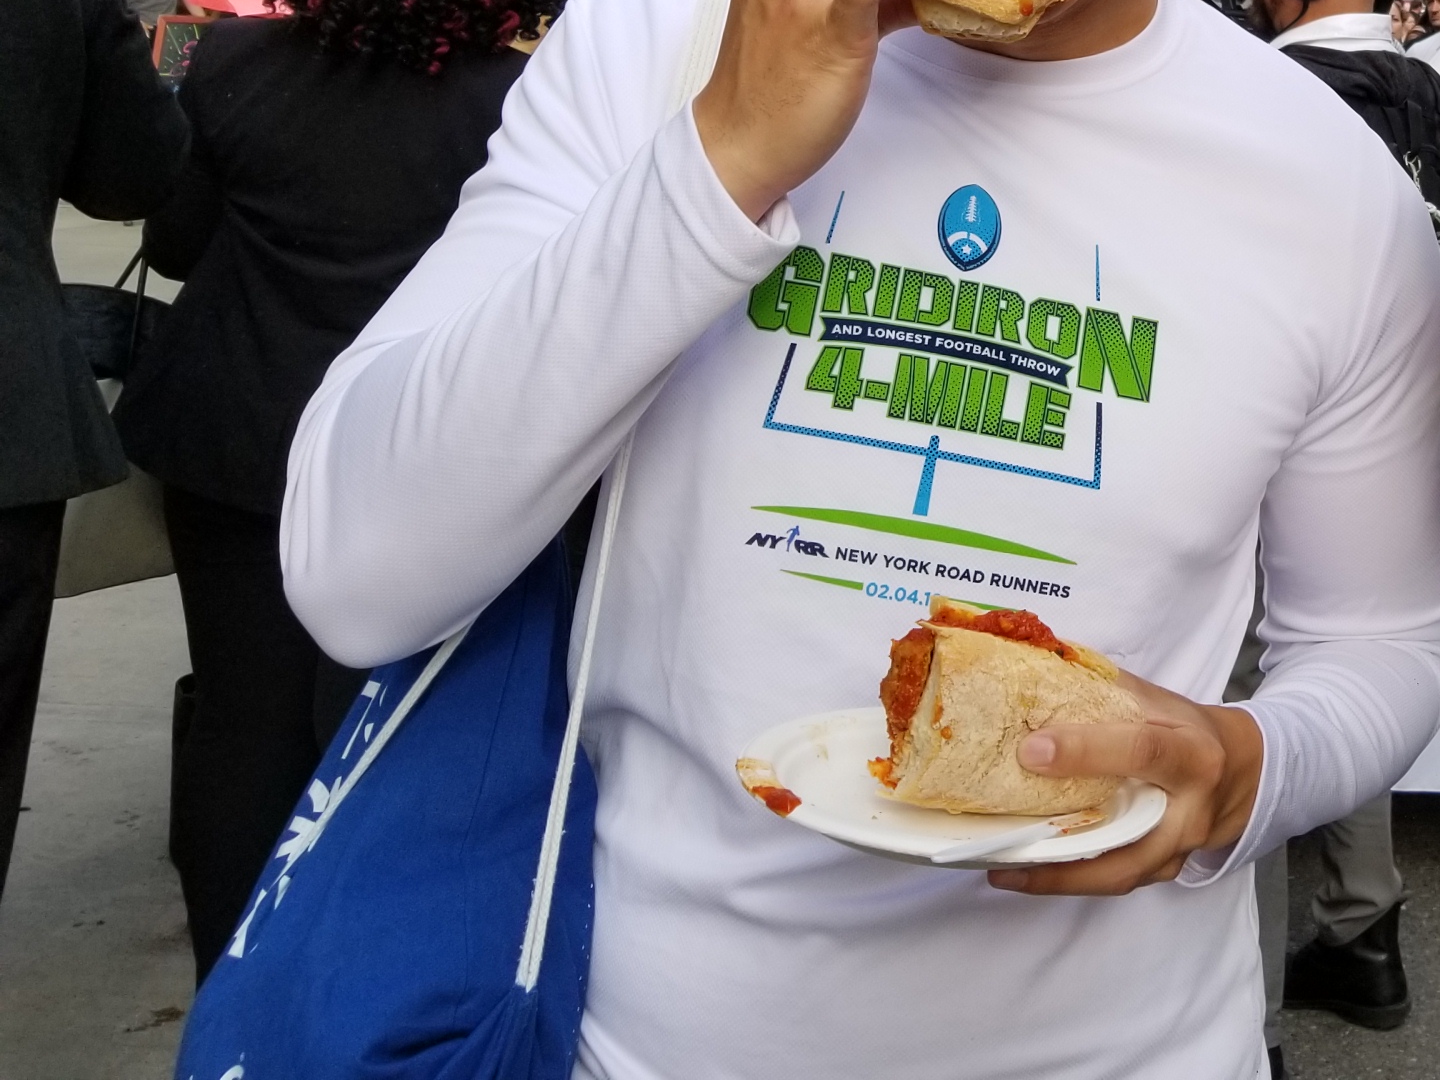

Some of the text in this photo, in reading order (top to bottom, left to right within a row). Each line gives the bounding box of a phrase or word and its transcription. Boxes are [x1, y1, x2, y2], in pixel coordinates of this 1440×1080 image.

[747, 245, 1159, 403] GRIDIRON
[831, 323, 1062, 377] AND LONGEST FOOTBALL THROW
[804, 345, 1072, 451] 4-MILE
[834, 546, 878, 565] NEW
[883, 554, 931, 575] YORK
[935, 563, 985, 584] ROAD
[990, 572, 1072, 599] RUNNERS
[864, 582, 941, 607] 02.04.1
